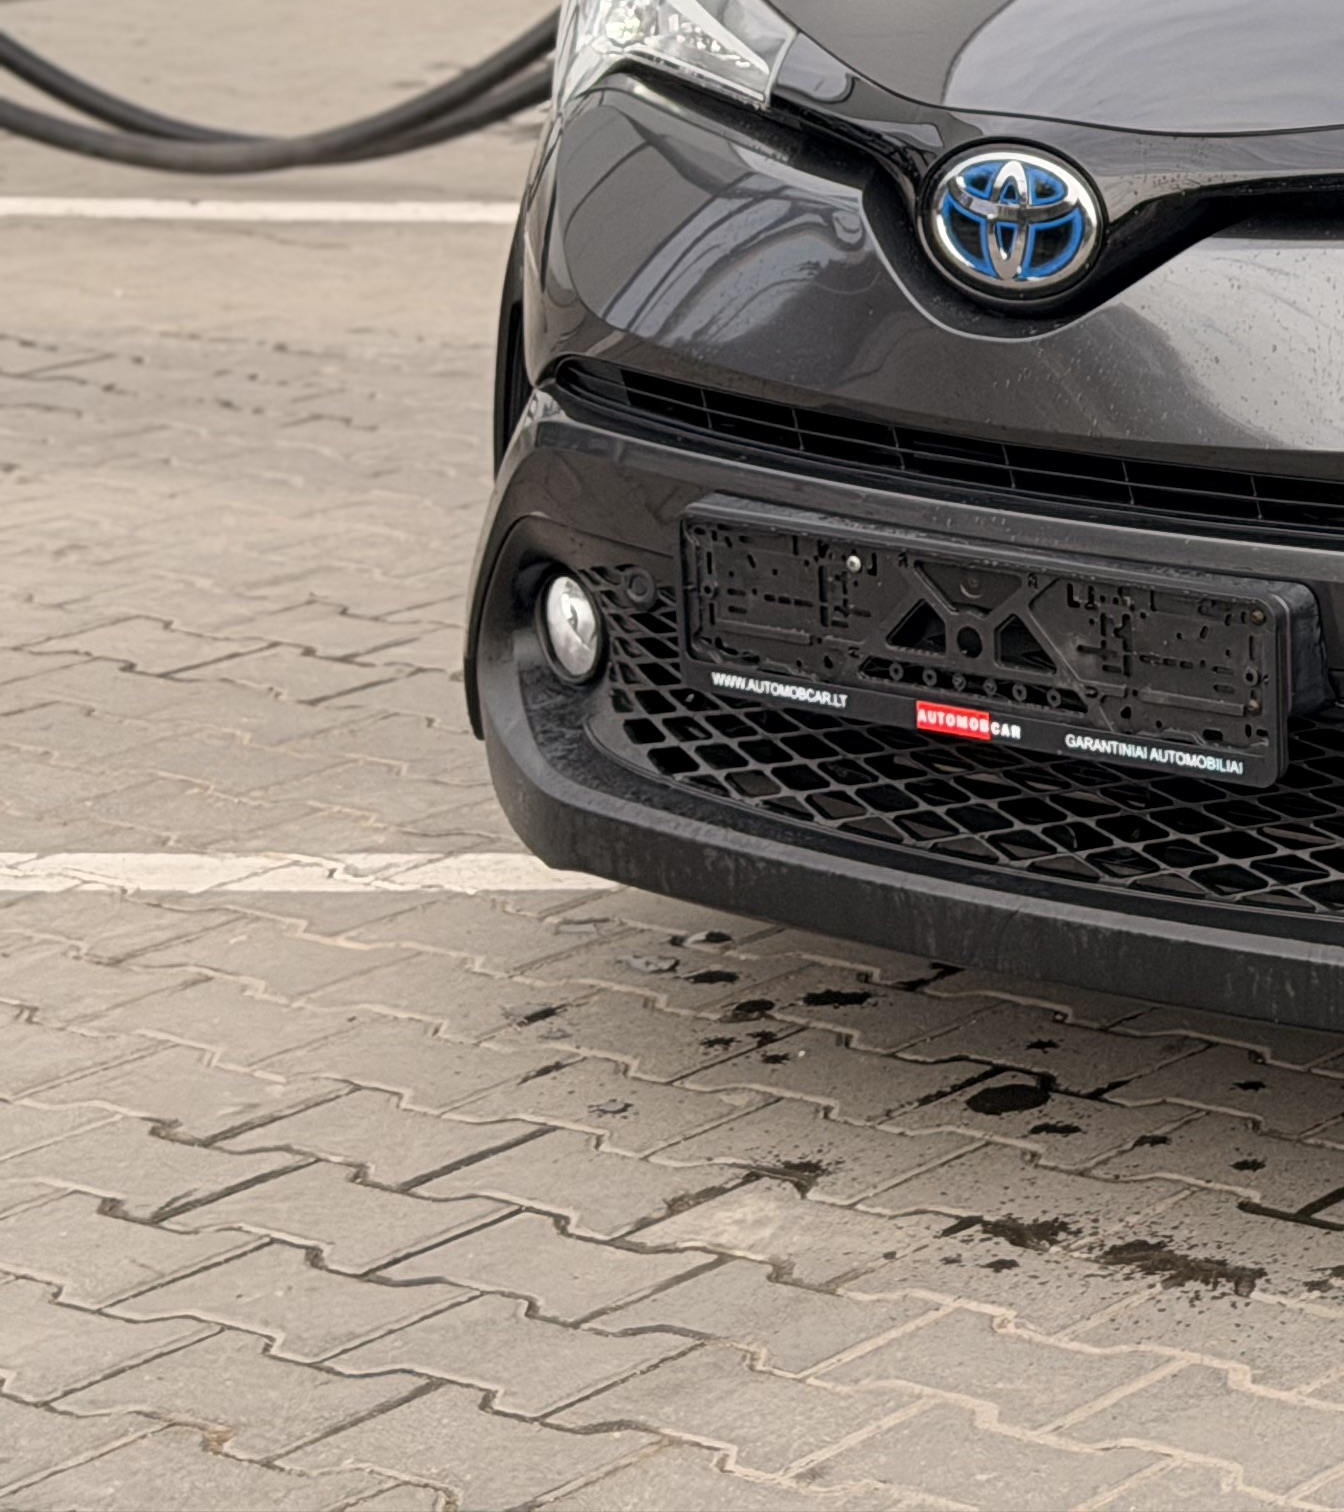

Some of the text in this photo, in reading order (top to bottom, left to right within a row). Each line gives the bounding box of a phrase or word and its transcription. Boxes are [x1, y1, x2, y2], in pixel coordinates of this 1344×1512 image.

[711, 671, 848, 708] WWW.AUTOMOBCAR.LT
[917, 709, 1021, 739] AUTOMOBCAR
[1065, 733, 1243, 775] GARANTINIAI AUTOMOBILIAI
